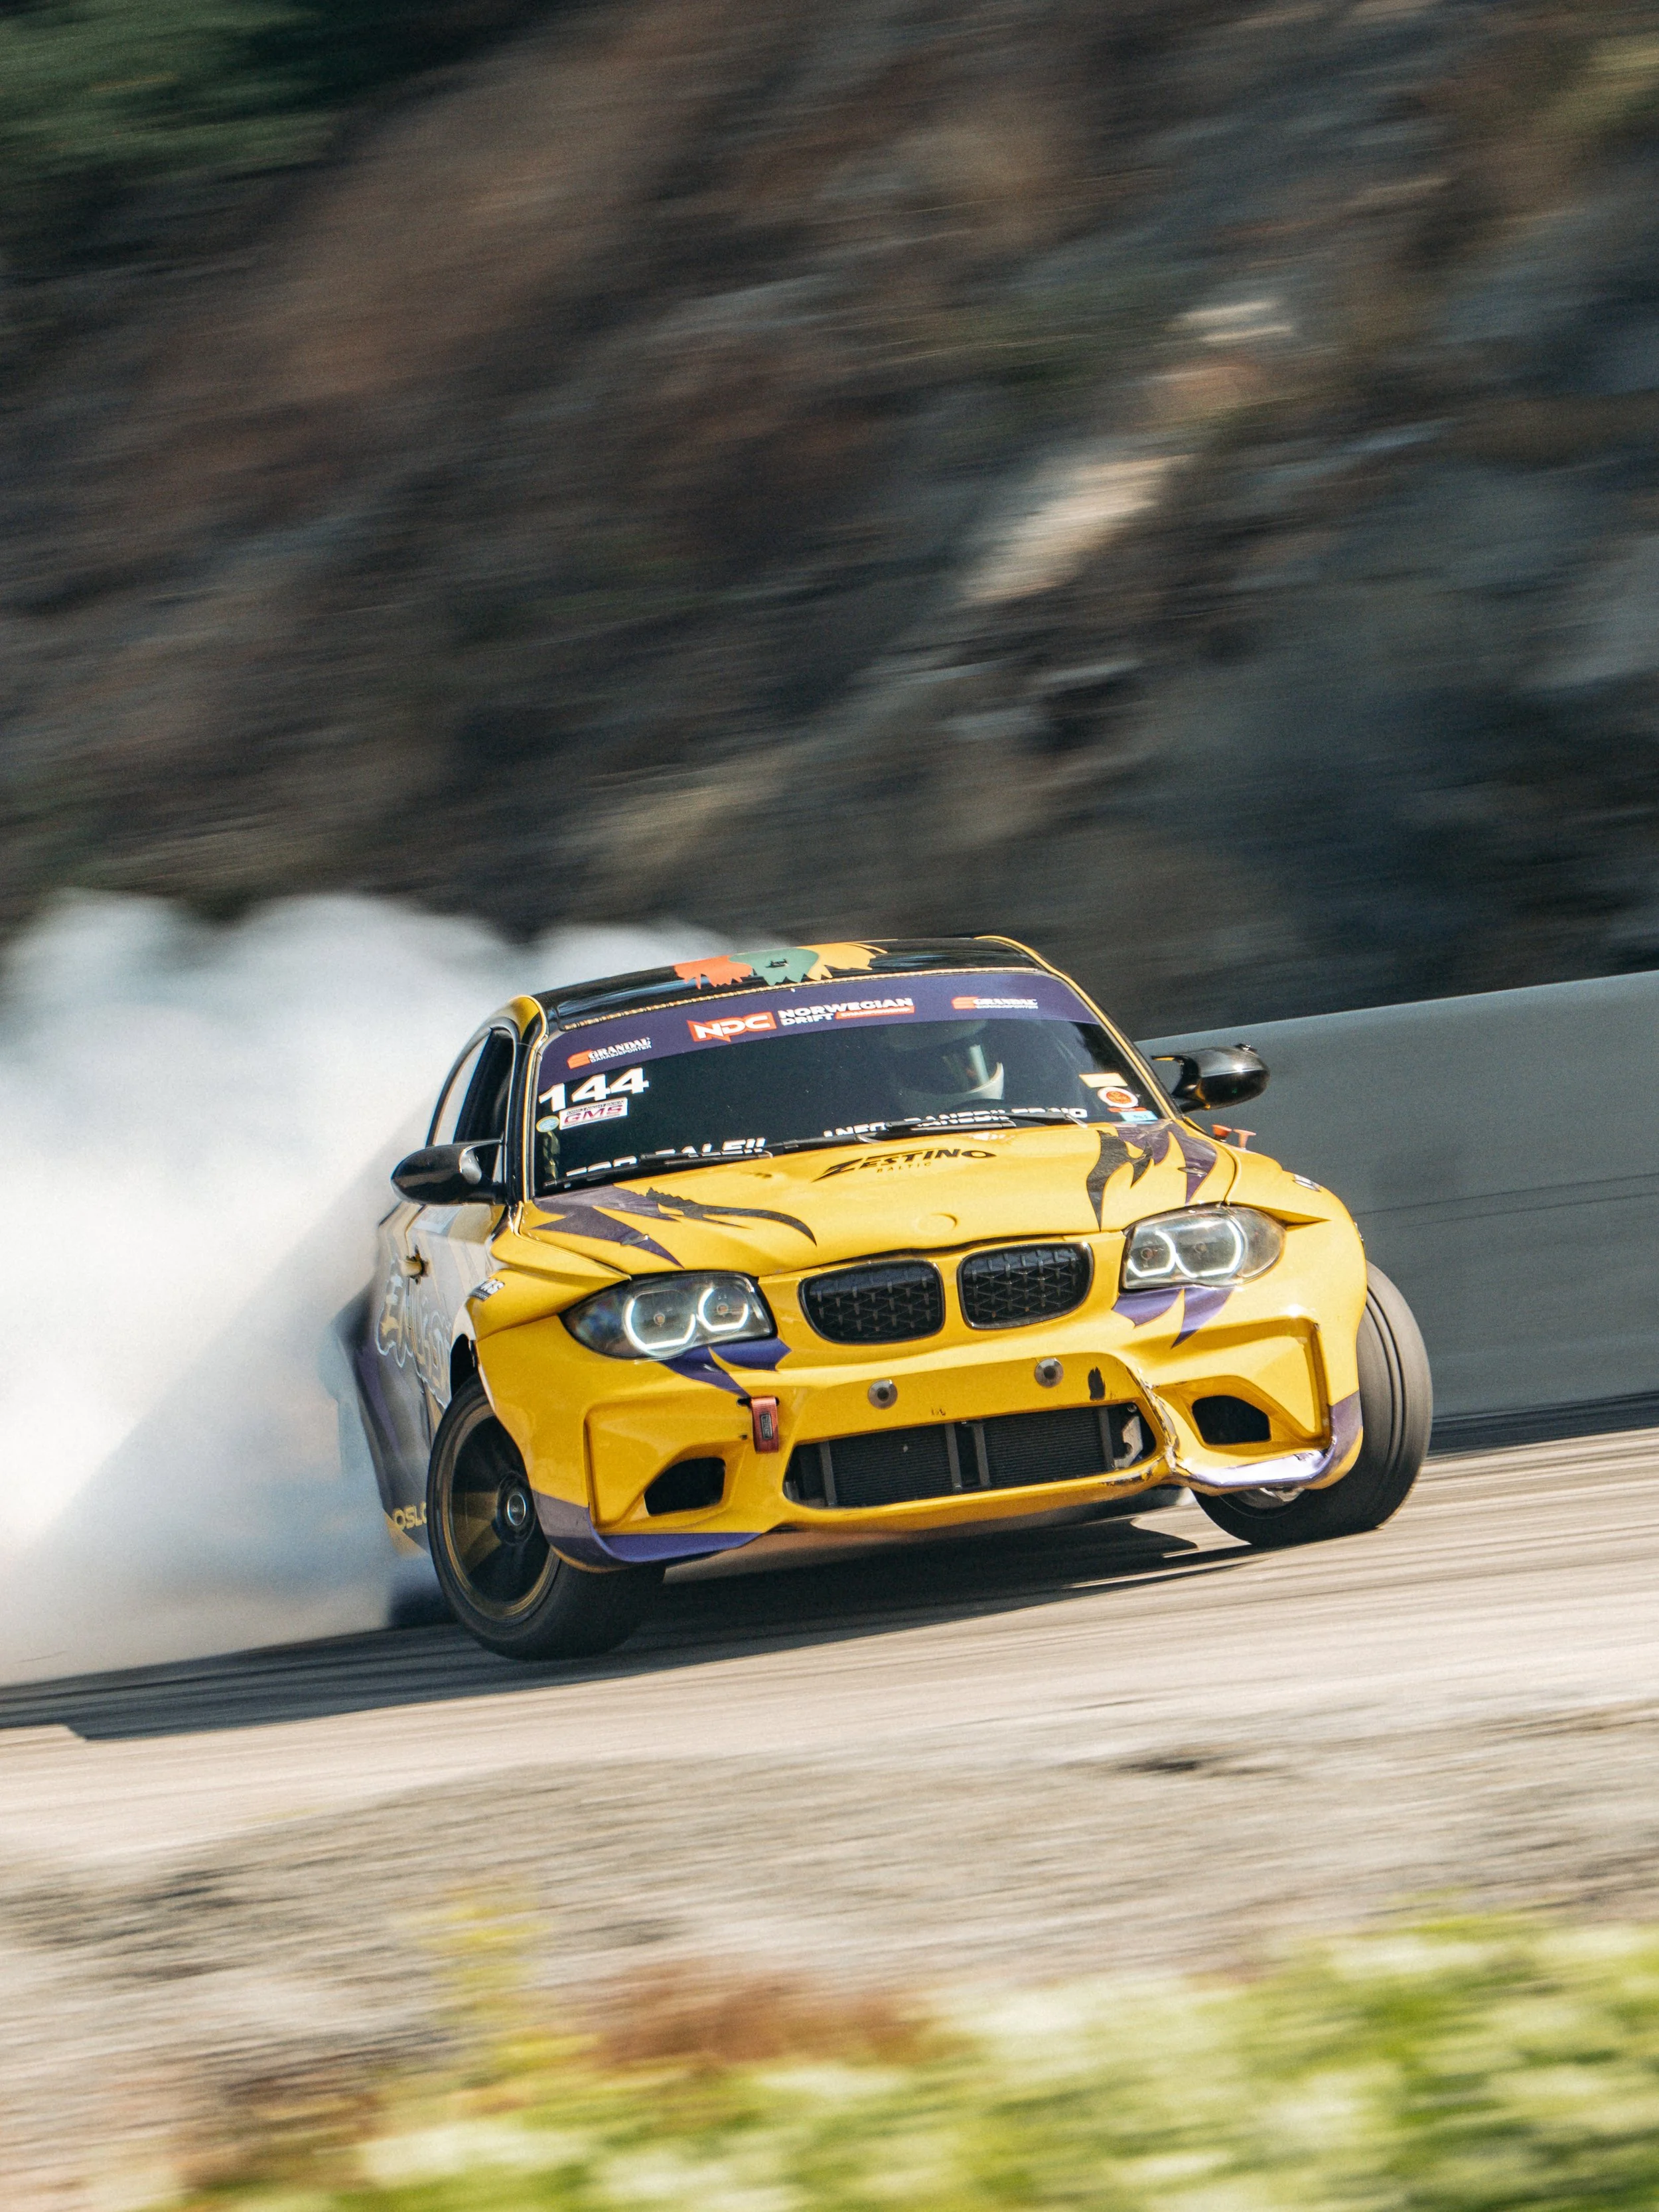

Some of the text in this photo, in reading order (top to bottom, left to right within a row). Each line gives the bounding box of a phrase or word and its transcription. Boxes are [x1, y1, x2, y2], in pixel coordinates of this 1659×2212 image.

[777, 997, 914, 1019] NORWEGIAN
[693, 1015, 771, 1041] NDC
[779, 1013, 835, 1027] DRIFT
[538, 1067, 650, 1112] 144
[564, 1104, 623, 1124] GMS
[812, 1149, 997, 1183] ZESTINO
[876, 1161, 931, 1173] BALTIC
